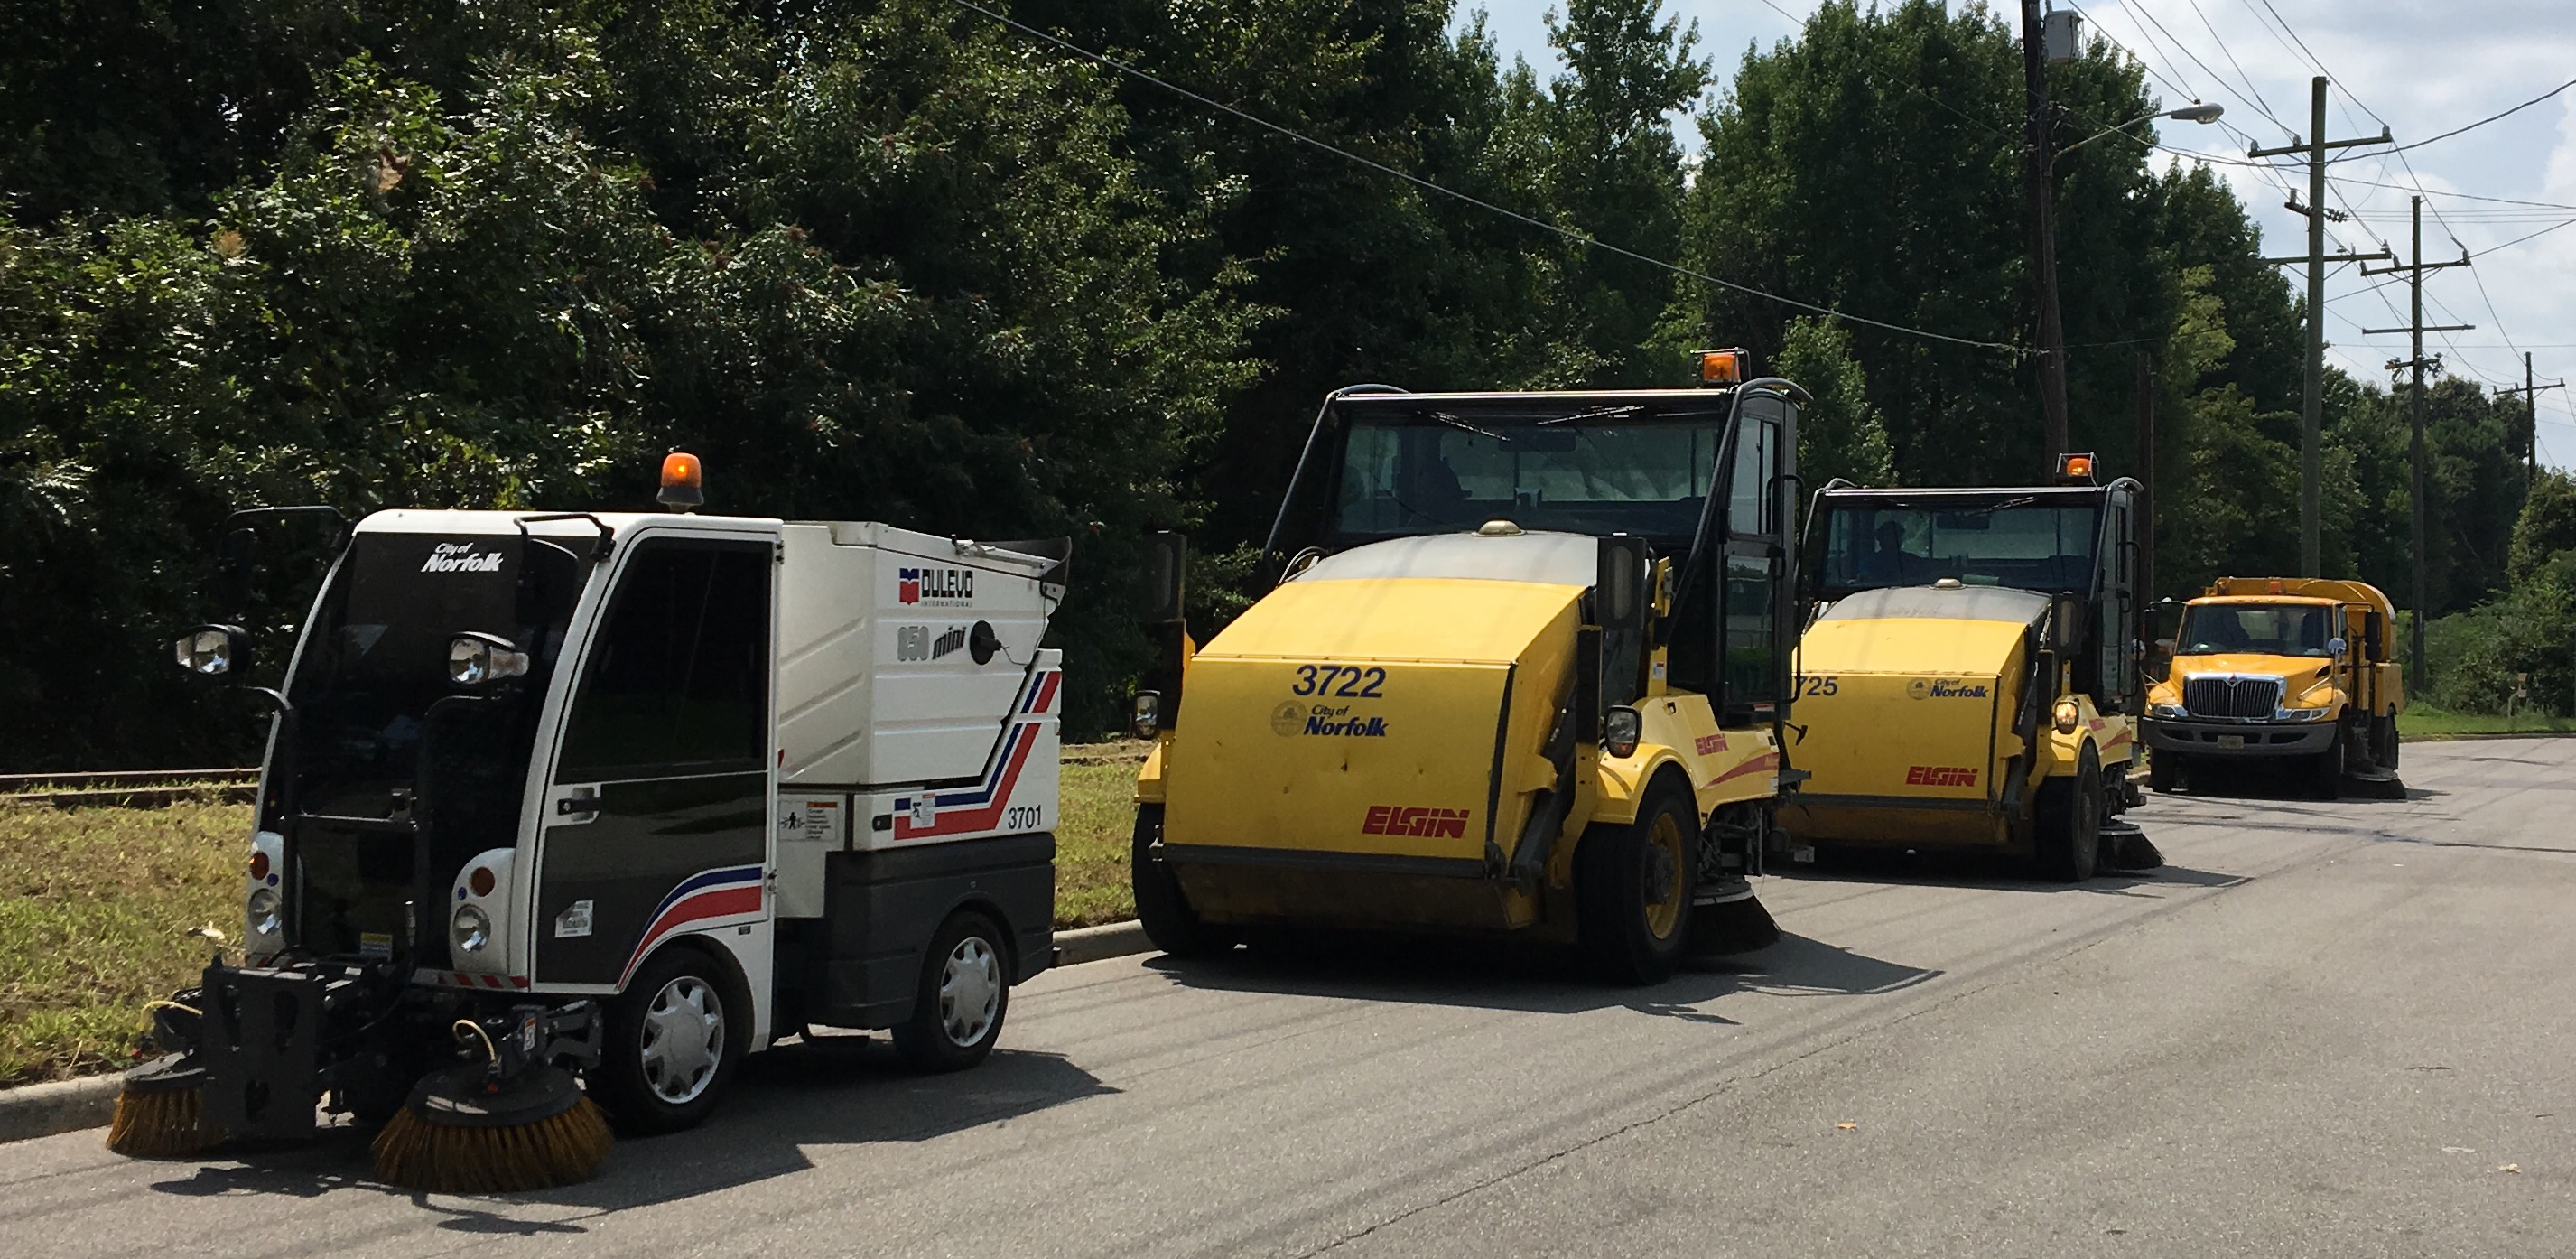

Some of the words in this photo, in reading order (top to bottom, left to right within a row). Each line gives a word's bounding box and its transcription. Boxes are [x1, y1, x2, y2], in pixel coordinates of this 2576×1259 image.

[435, 542, 459, 556] City
[457, 542, 474, 554] of
[421, 552, 504, 572] Norfolk
[921, 569, 973, 598] DULEVO
[932, 624, 967, 660] mini
[1292, 665, 1387, 698] 3722
[1930, 685, 1989, 698] Norfolk
[1311, 704, 1335, 719] City
[1335, 704, 1351, 716] of
[1303, 716, 1389, 737] Norfolk
[1694, 732, 1729, 757] ELGIN
[1905, 765, 1979, 788] ELGIN
[1008, 804, 1041, 830] 3701
[1362, 805, 1471, 839] ELGIN
